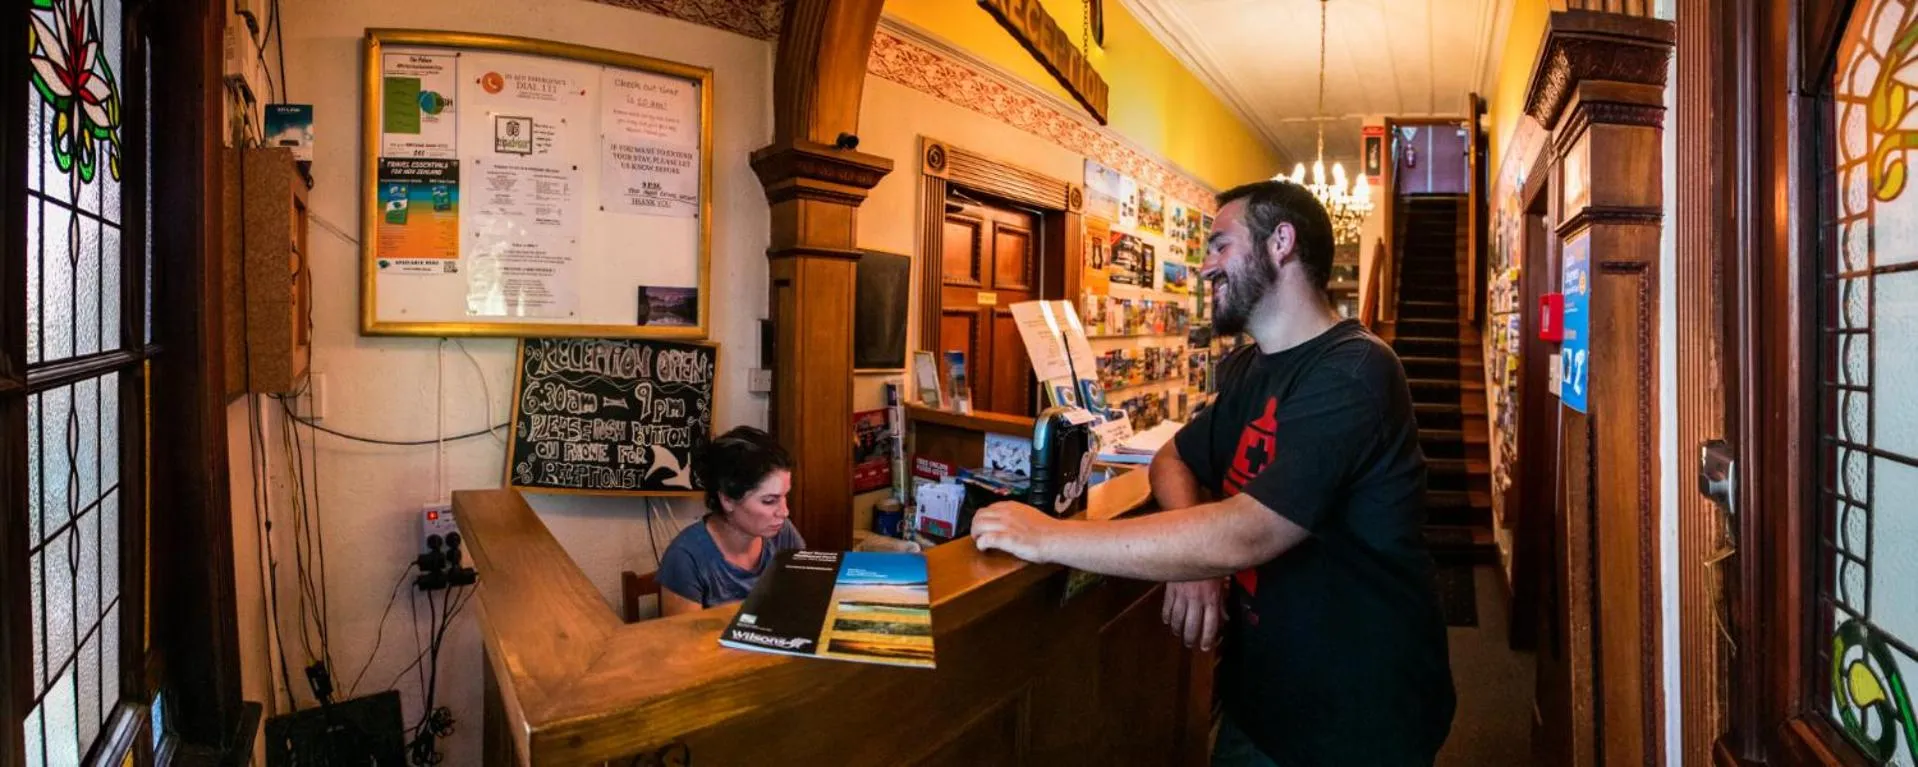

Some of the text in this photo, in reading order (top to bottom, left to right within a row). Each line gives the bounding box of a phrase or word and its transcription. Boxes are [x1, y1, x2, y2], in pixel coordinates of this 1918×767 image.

[997, 0, 1106, 113] ECEPTION
[527, 75, 566, 85] EMERGENCY
[614, 79, 641, 90] Check
[516, 82, 557, 94] DIAL 111
[613, 152, 632, 160] YOUR
[653, 157, 677, 165] PLEASE
[666, 150, 693, 160] EXTEND
[655, 166, 681, 175] BEFORE
[632, 198, 656, 207] THANK
[535, 339, 708, 384] RECEPTION OPEN
[522, 382, 598, 415] 6:30am
[527, 414, 691, 448] PLEASE PUSH BUTTON
[535, 441, 649, 465] ON PHONE FOR
[538, 461, 645, 489] RECEPTIONIST
[731, 629, 786, 647] Wilsons
